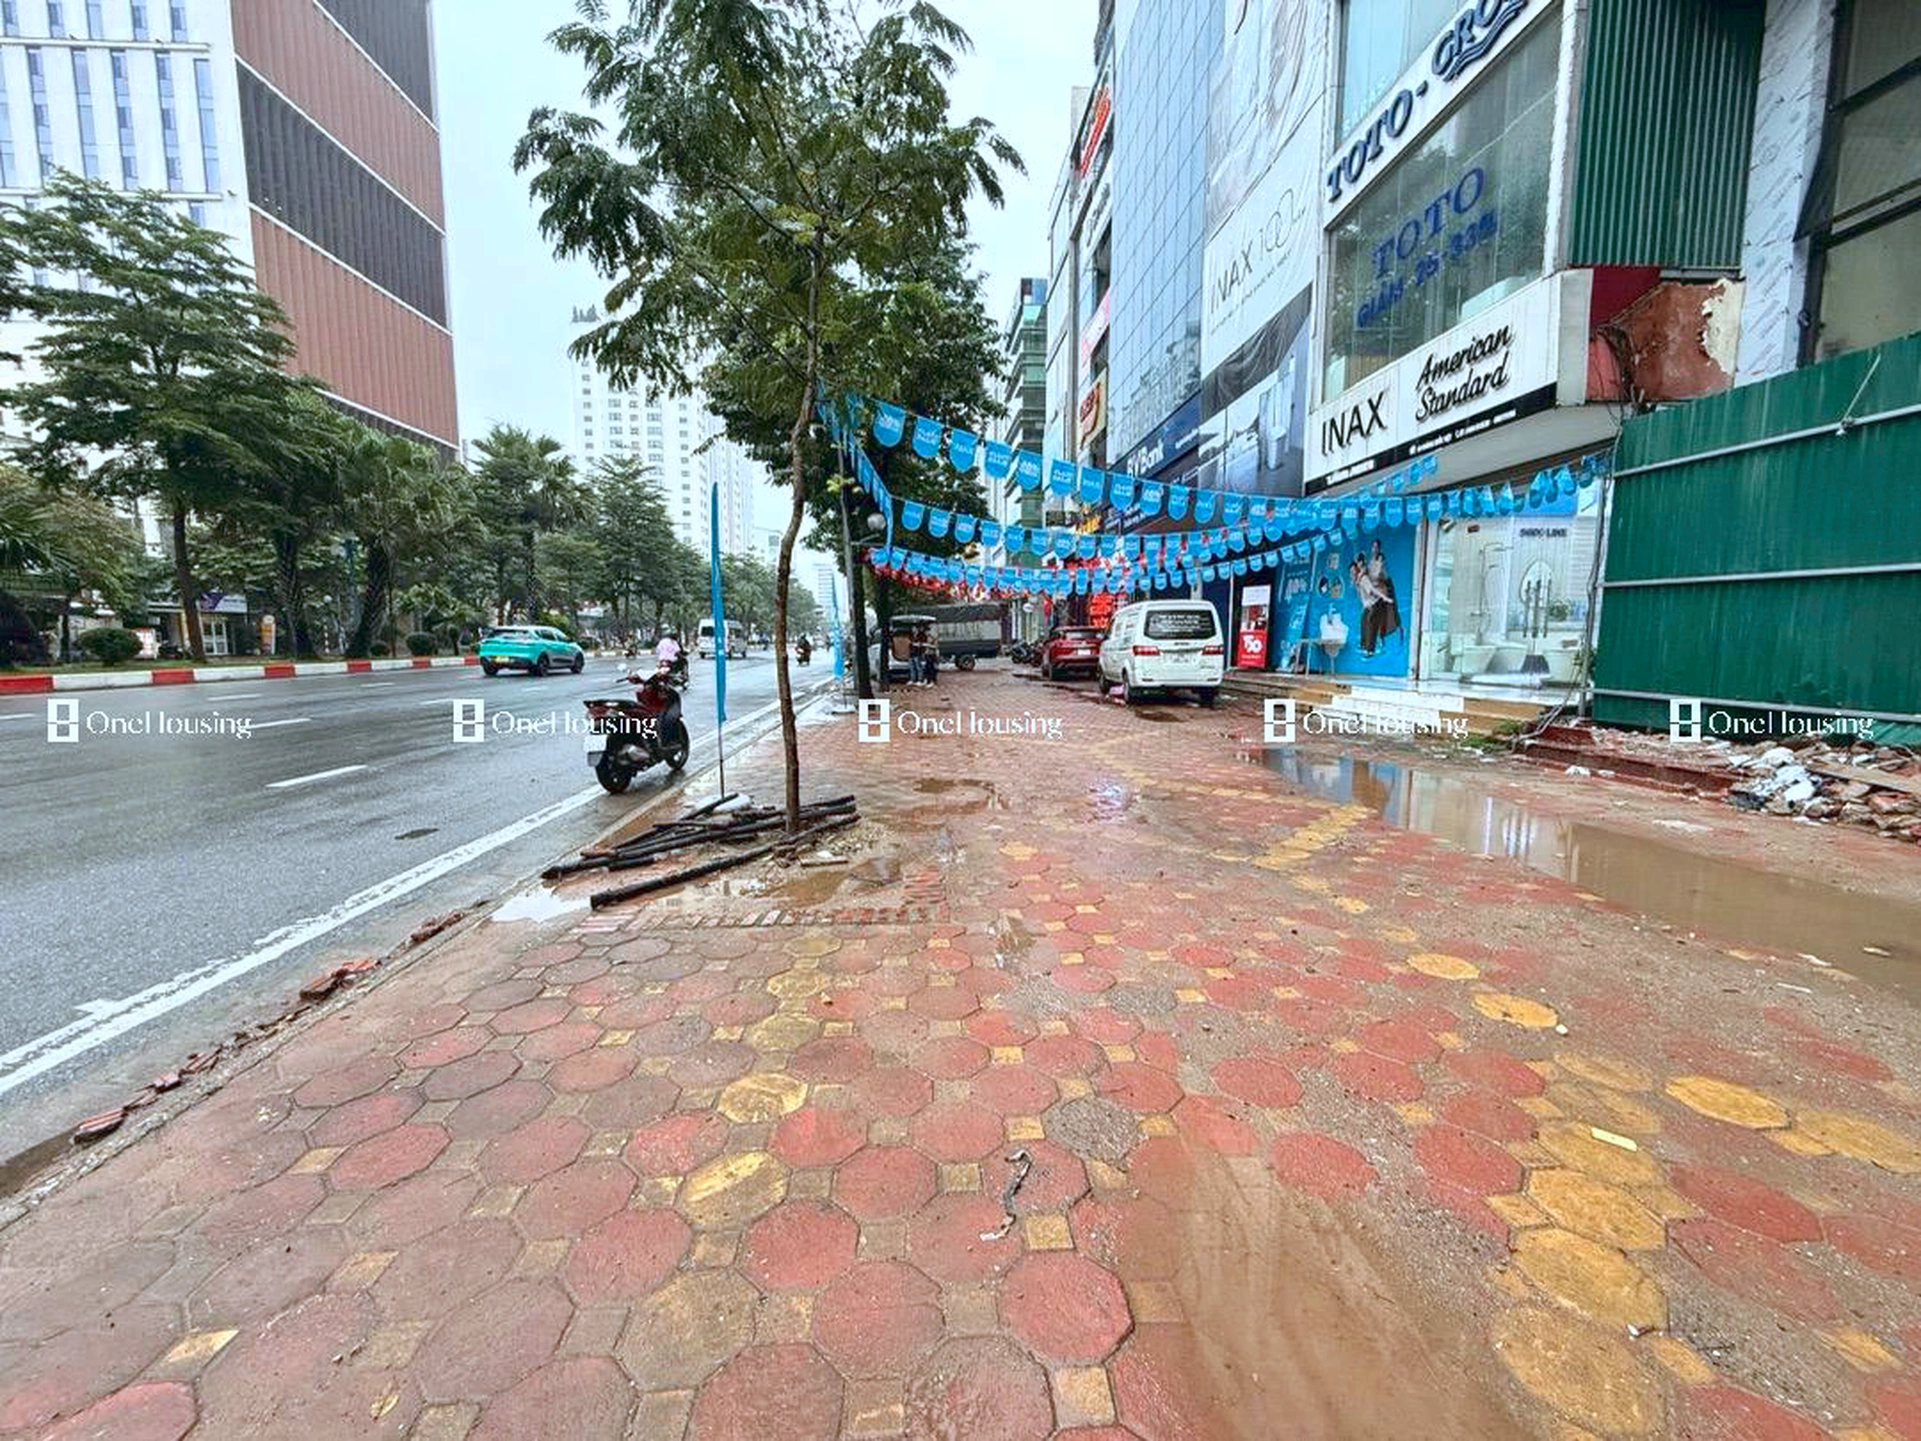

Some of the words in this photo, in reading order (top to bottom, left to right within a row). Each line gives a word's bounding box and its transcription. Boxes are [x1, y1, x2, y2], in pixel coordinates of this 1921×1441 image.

[1327, 89, 1413, 203] TOTO
[1373, 167, 1484, 279] TOTO
[1210, 240, 1253, 314] INAX
[1416, 325, 1512, 391] American
[1416, 350, 1509, 422] Standard
[1322, 391, 1388, 457] INAX
